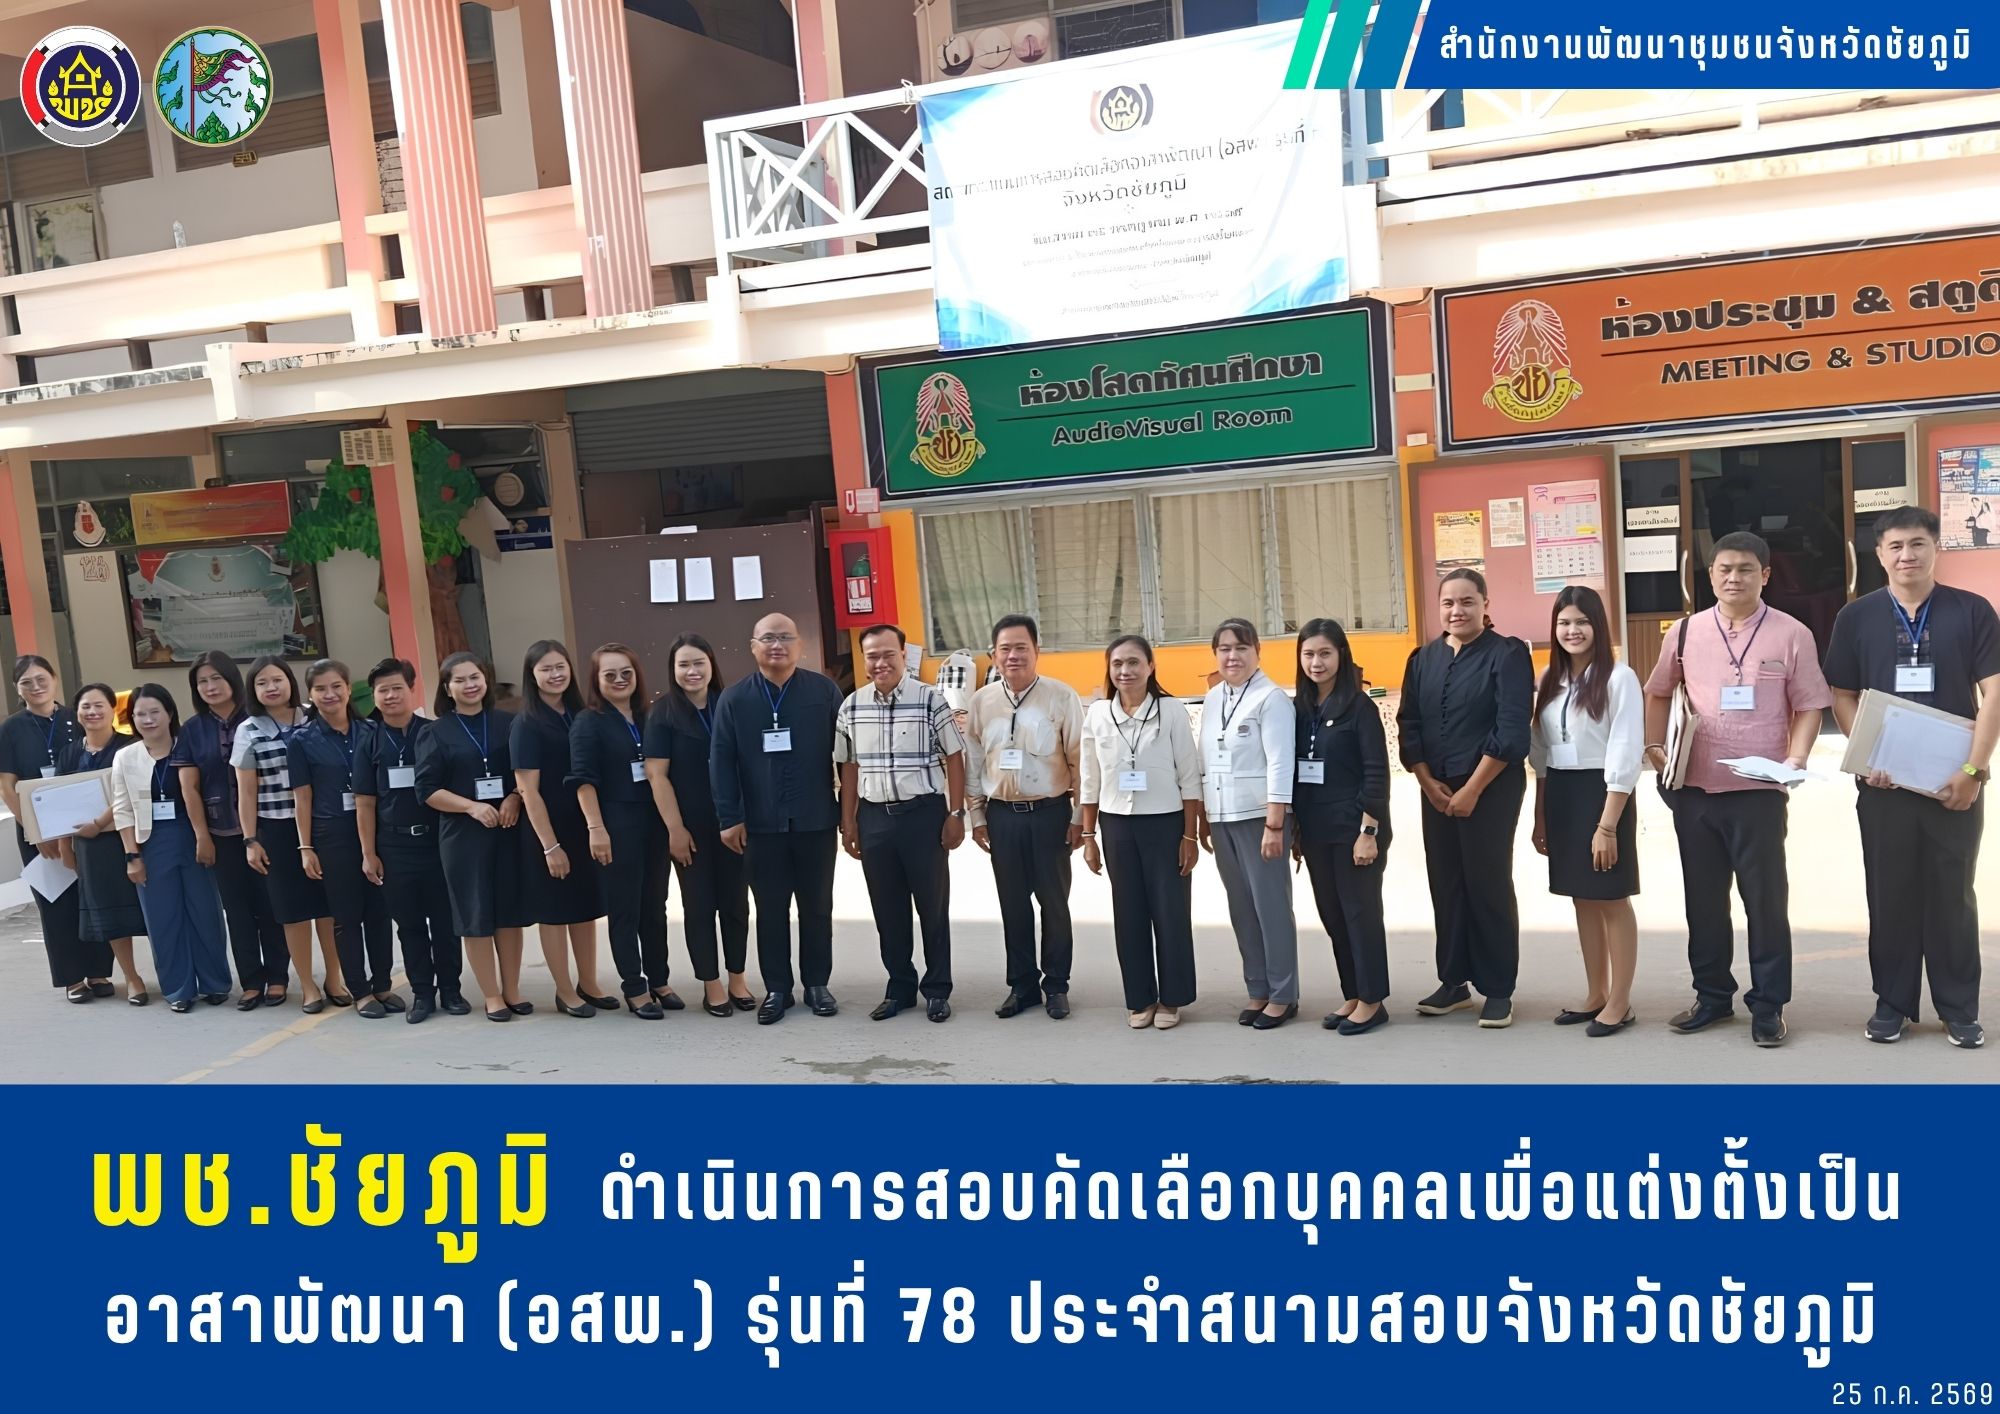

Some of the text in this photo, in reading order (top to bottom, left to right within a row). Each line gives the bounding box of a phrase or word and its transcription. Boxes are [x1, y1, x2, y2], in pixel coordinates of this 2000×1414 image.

[1601, 293, 1837, 341] ห้องประชุม
[1852, 285, 1895, 316] &
[1660, 331, 2000, 385] MEETING & STUDIO
[1051, 406, 1293, 447] AudioVisual Room
